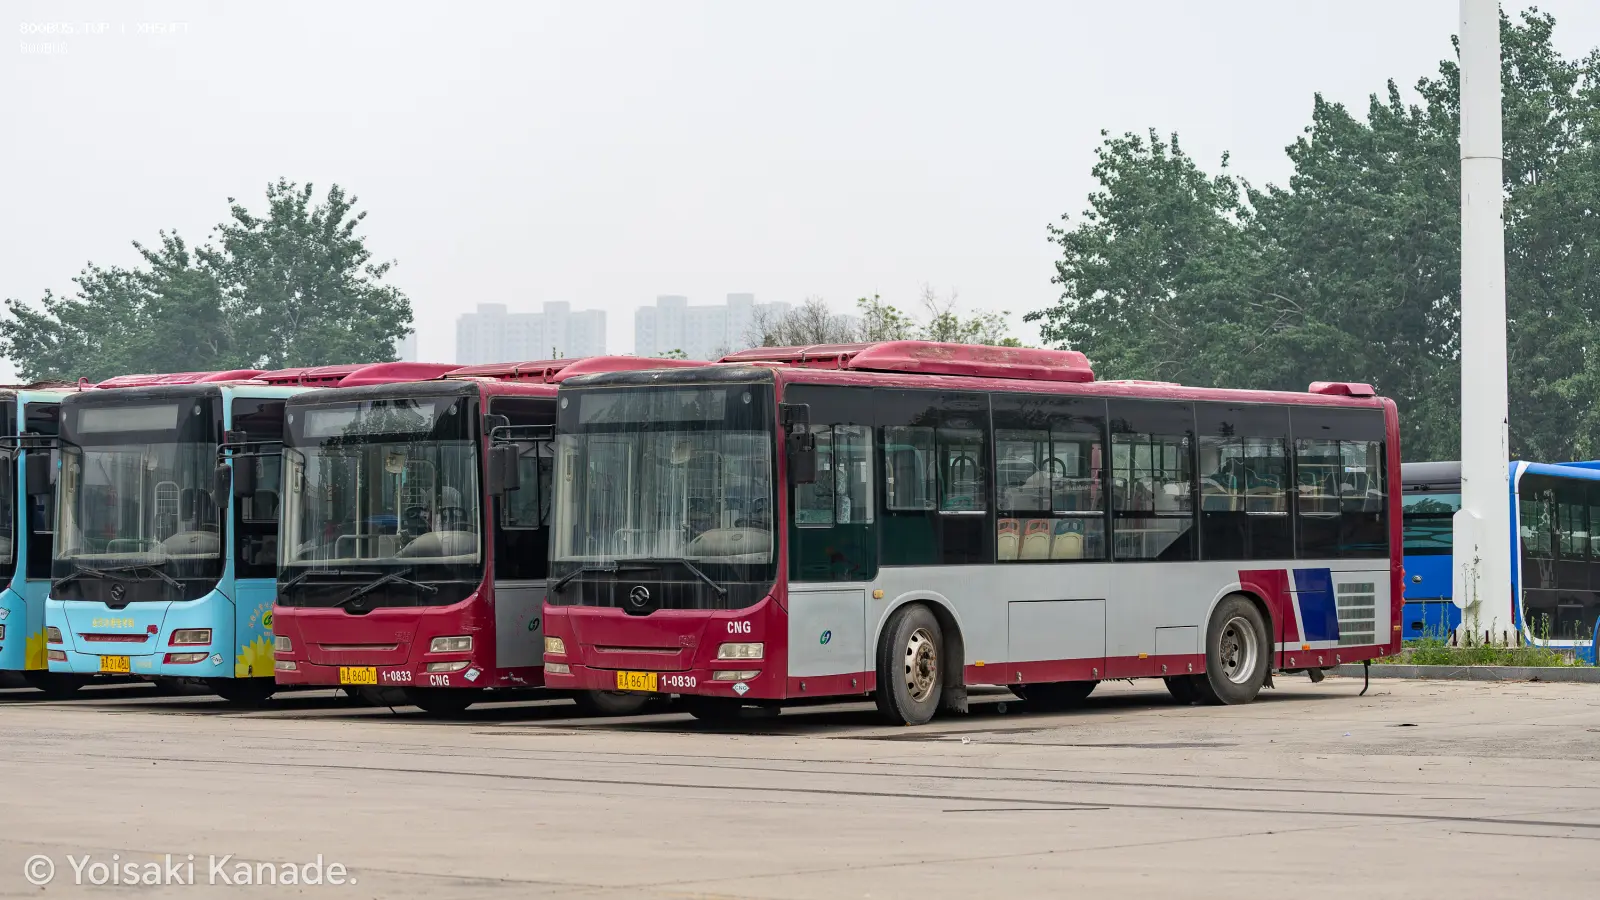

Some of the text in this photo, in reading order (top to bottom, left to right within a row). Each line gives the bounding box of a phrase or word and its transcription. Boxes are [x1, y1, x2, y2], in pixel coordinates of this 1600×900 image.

[727, 620, 751, 634] CNG
[382, 670, 412, 682] 1-0833
[429, 674, 450, 686] CNG
[661, 675, 697, 688] 1-0830
